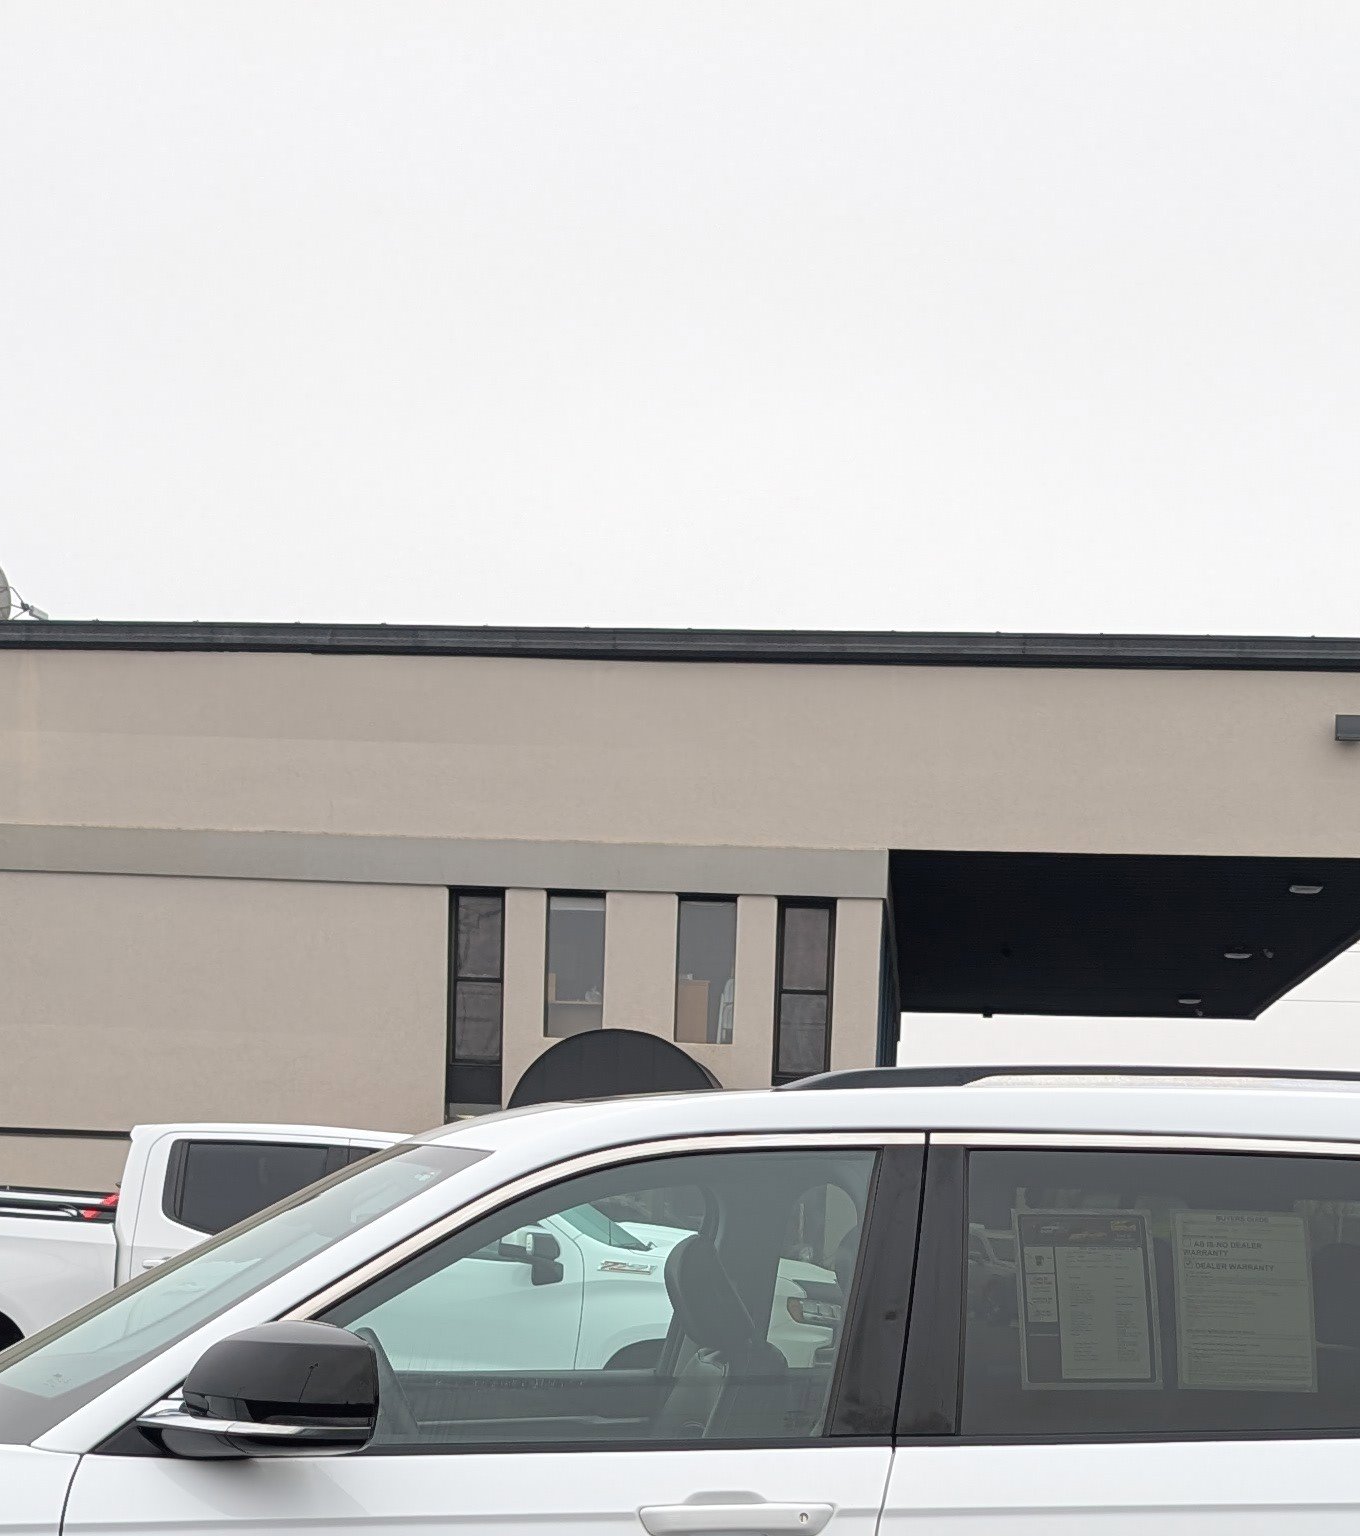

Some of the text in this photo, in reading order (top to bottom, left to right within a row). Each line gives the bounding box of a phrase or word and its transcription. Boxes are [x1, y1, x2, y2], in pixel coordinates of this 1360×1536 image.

[1230, 1241, 1263, 1249] DEALER
[1195, 1262, 1274, 1272] DEALER WARRANTY
